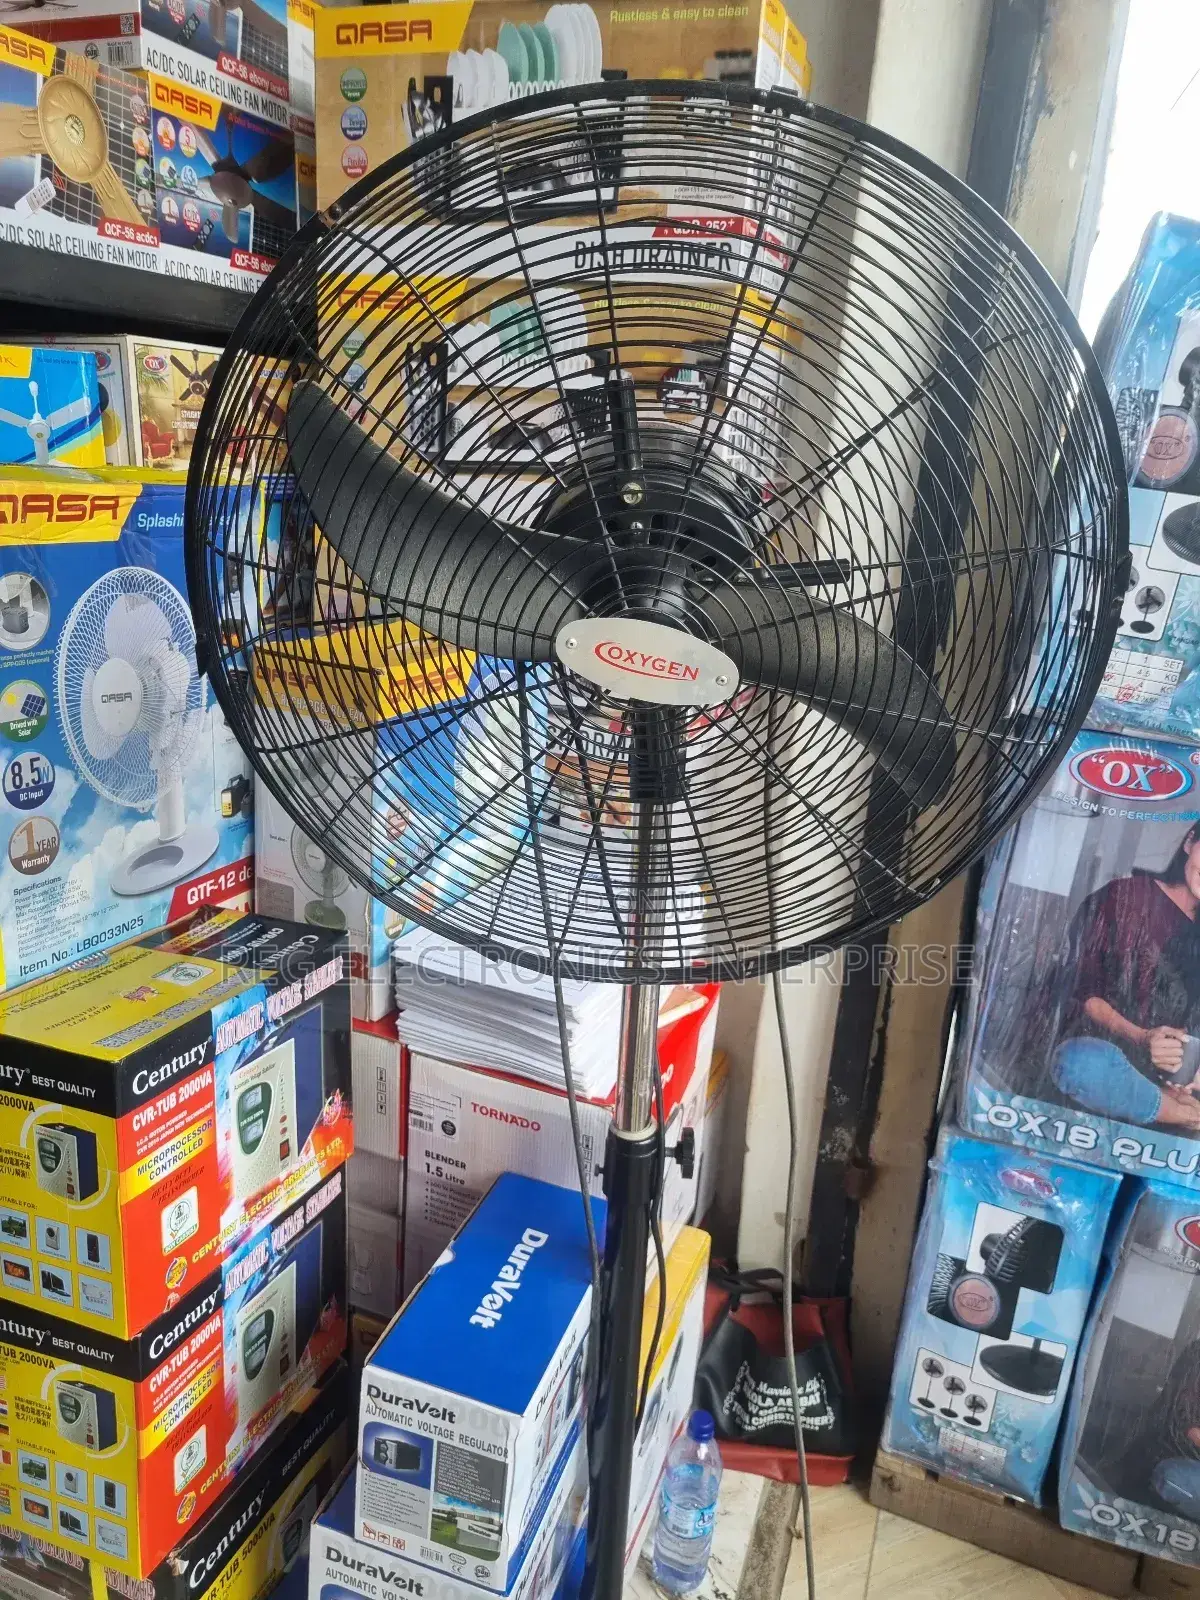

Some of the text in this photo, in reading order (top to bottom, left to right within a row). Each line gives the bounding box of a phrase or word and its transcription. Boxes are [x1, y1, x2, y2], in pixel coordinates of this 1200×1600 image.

[610, 5, 749, 24] Rustless & easy to clean
[336, 19, 432, 45] QASA
[146, 47, 174, 76] AC/DC
[177, 61, 206, 92] SOLAR
[209, 73, 242, 104] CEILING
[244, 90, 259, 110] FAN
[261, 97, 288, 125] MOTOR
[221, 56, 270, 92] QCF-56 ebony
[155, 83, 213, 120] QASA
[105, 222, 158, 245] QCF-56 acdc1
[27, 228, 62, 252] SOLAR
[66, 236, 104, 260] CEILING
[107, 244, 124, 263] FAN
[127, 248, 158, 271] MOTOR
[234, 253, 259, 270] QCF-56
[575, 241, 732, 271] DISH DRAINER
[164, 259, 255, 293] AC/DC SOLAR CEILING
[608, 646, 700, 681] OXYGEN
[1163, 660, 1182, 670] SET
[1164, 673, 1178, 682] KG
[101, 692, 132, 703] QASA
[10, 719, 38, 730] Drived with
[18, 729, 31, 737] Solar
[20, 790, 44, 801] DC Input
[1101, 805, 1116, 816] TO
[37, 836, 57, 851] YEAR
[21, 854, 51, 869] Warranty
[13, 876, 62, 896] Specifications
[186, 868, 235, 905] QTF-12
[19, 959, 48, 977] Item
[51, 949, 74, 965] No.:
[215, 1002, 265, 1056] AUTOMATIC
[267, 982, 302, 1014] VOLTAGE
[304, 955, 344, 996] STABILIZER
[132, 1038, 208, 1096] Century
[32, 1074, 96, 1099] BEST QUALITY
[132, 1070, 213, 1132] CVR-TUB 2000VA
[0, 1094, 36, 1113] 2000VA
[185, 1101, 214, 1125] TECHNOLOGY
[470, 1101, 542, 1132] TORNADO
[166, 1109, 188, 1130] POWERED
[137, 1118, 213, 1177] MICROPROCESSOR
[149, 1137, 204, 1181] CONTROLLED
[424, 1149, 467, 1170] BLENDER
[1111, 1136, 1200, 1177] PLU
[425, 1162, 466, 1186] 1.5 Litre
[192, 1219, 237, 1263] CENTURY
[239, 1186, 282, 1223] ELECTRIC
[282, 1152, 327, 1193] PRODUCTS
[224, 1238, 269, 1300] AUTOMATIC
[271, 1205, 305, 1249] VOLTAGE
[305, 1171, 342, 1225] STABILIZER
[468, 1226, 550, 1330] DuraVolt
[149, 1287, 217, 1360] Century
[19, 1351, 56, 1370] 2000VA
[52, 1336, 76, 1351] BEST
[77, 1344, 115, 1362] QUALITY
[149, 1314, 222, 1393] CVR-TUB 2000VA
[153, 1359, 220, 1433] MICROPROCESSOR
[366, 1383, 457, 1424] DuraVolt
[756, 1380, 805, 1397] Marriae
[163, 1379, 213, 1433] CONTROLLED
[751, 1412, 829, 1426] CHRISTPHER
[16, 1438, 44, 1453] SUITABLE
[282, 1447, 301, 1476] BEST
[302, 1408, 336, 1452] QUALITY
[365, 1403, 508, 1459] AUTOMATIC VOLTAGE REGULATOR
[200, 1444, 241, 1494] CENTURY
[189, 1487, 266, 1589] Century
[241, 1513, 276, 1561] 5000VA
[325, 1545, 424, 1597] DuraVolt
[325, 1566, 377, 1596] AUTOMATIC
